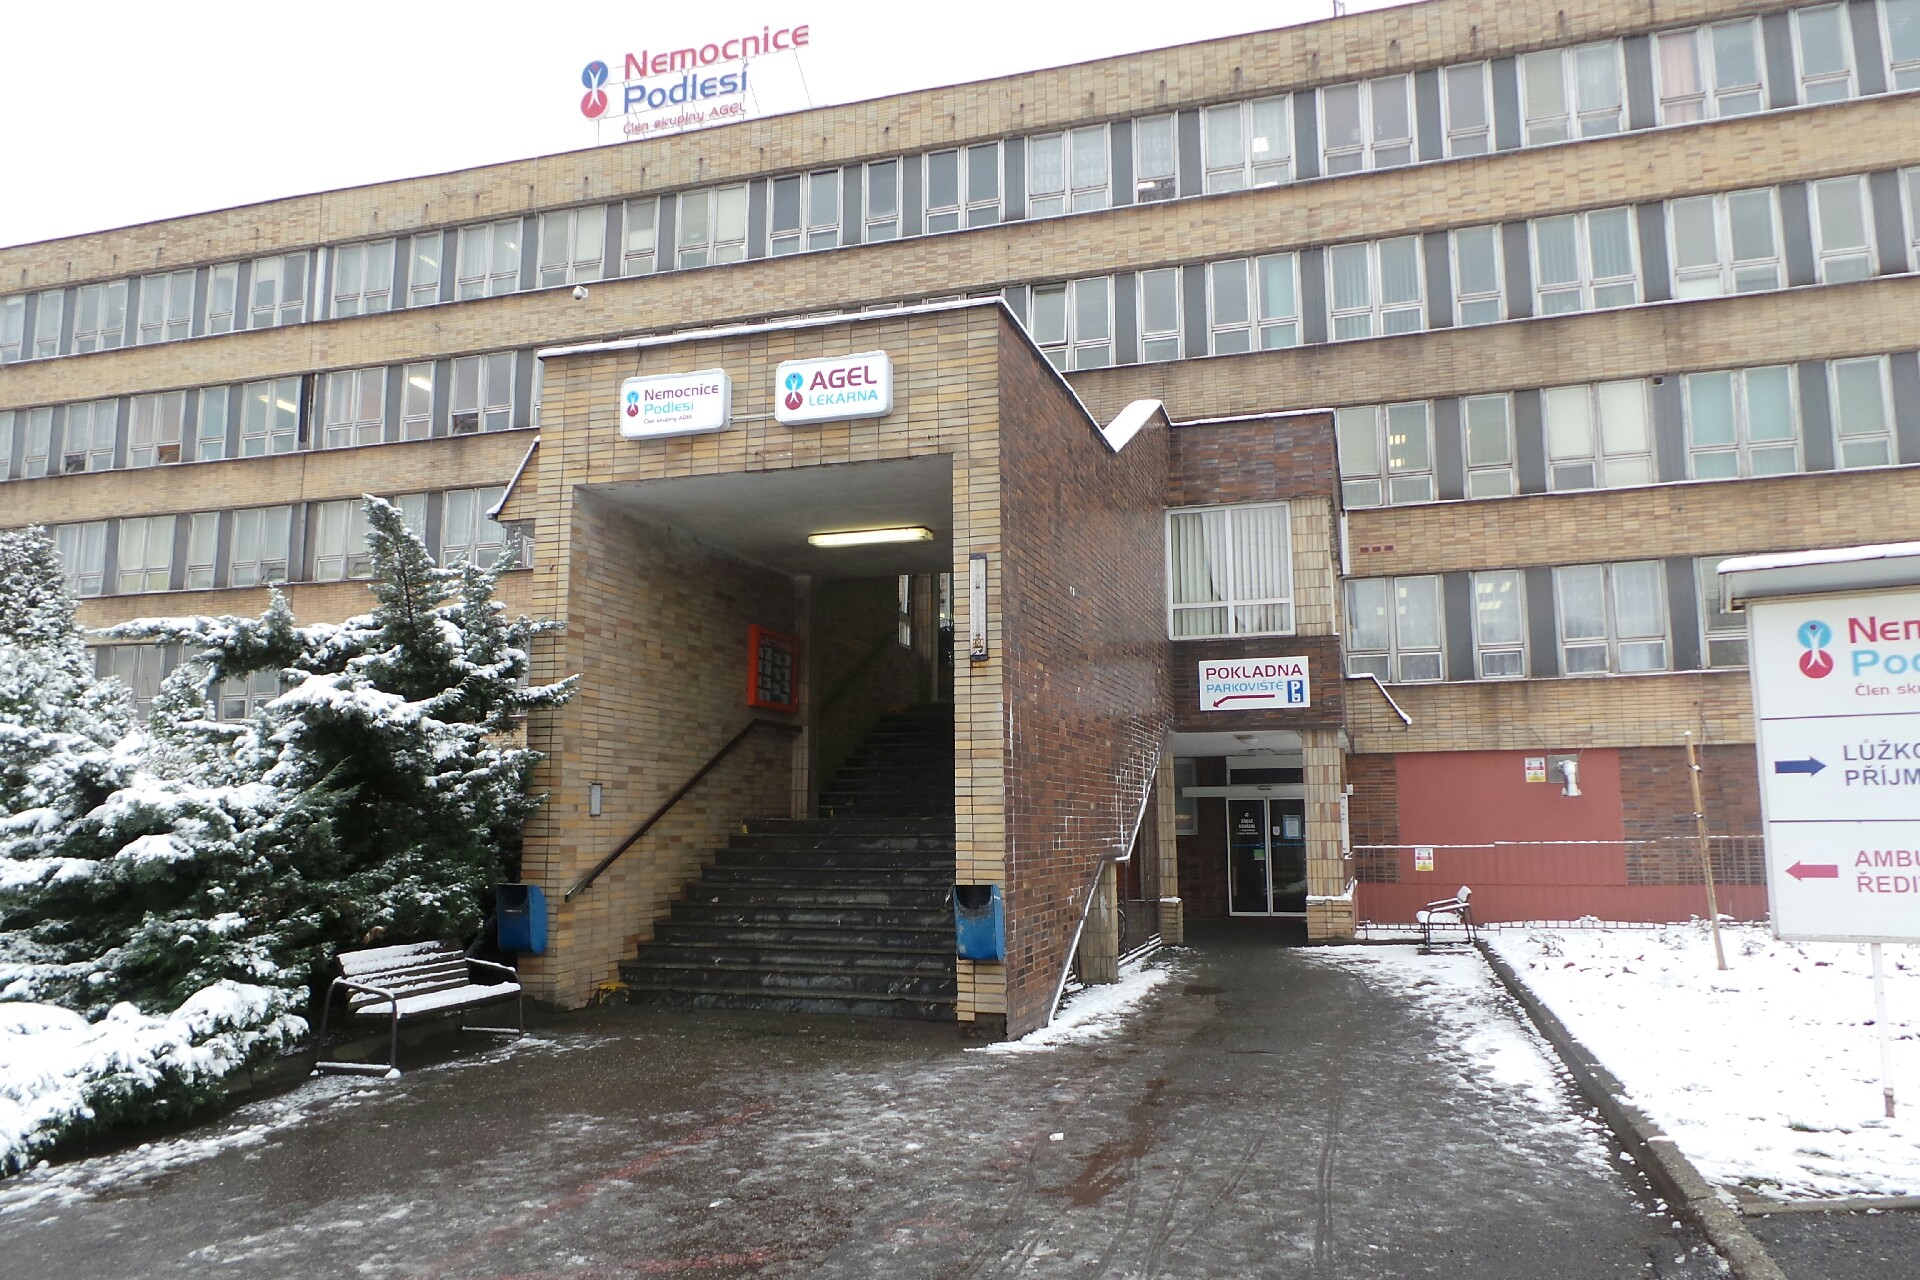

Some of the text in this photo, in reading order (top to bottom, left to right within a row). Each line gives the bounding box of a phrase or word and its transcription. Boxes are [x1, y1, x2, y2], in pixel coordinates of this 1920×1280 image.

[625, 24, 809, 79] Nemocnice
[709, 102, 746, 118] AGEL
[809, 365, 877, 391] AGEL
[644, 383, 719, 401] Nemocnice
[809, 389, 879, 406] LÉKÁRNA
[1205, 664, 1303, 680] POKLADNA
[1855, 682, 1920, 696] Člen sk
[1857, 871, 1920, 893] ŘEDI
